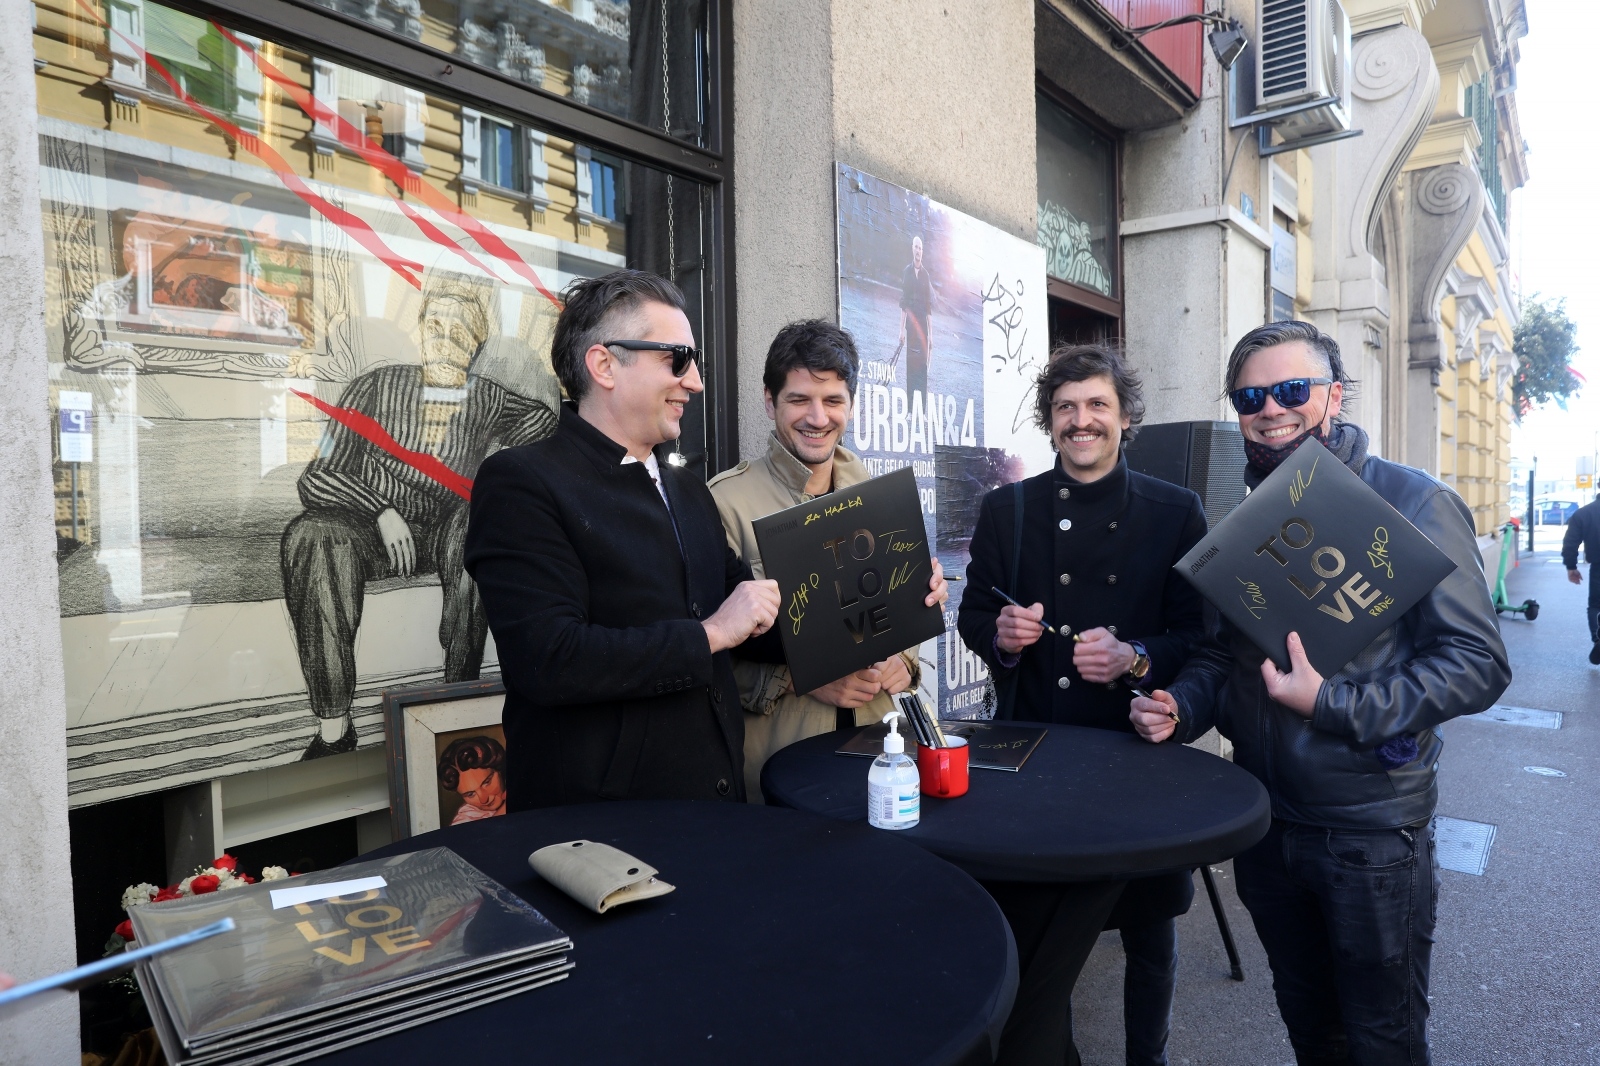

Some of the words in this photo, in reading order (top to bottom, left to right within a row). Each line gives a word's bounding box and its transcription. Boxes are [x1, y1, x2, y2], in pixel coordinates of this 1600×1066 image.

[867, 360, 897, 383] STAVAK
[853, 382, 977, 454] URBAN&4
[765, 519, 799, 539] JONATHAN
[823, 528, 876, 569] TO
[1254, 517, 1315, 567] TO
[1189, 545, 1220, 576] JONATHAN
[1287, 546, 1346, 600] LO
[834, 568, 884, 609] LO
[1317, 571, 1382, 623] VE
[1368, 595, 1395, 617] RADE
[843, 602, 892, 644] VE
[945, 697, 952, 714] &
[952, 690, 970, 711] ANTE
[295, 906, 403, 942] LO
[313, 926, 432, 966] VE
